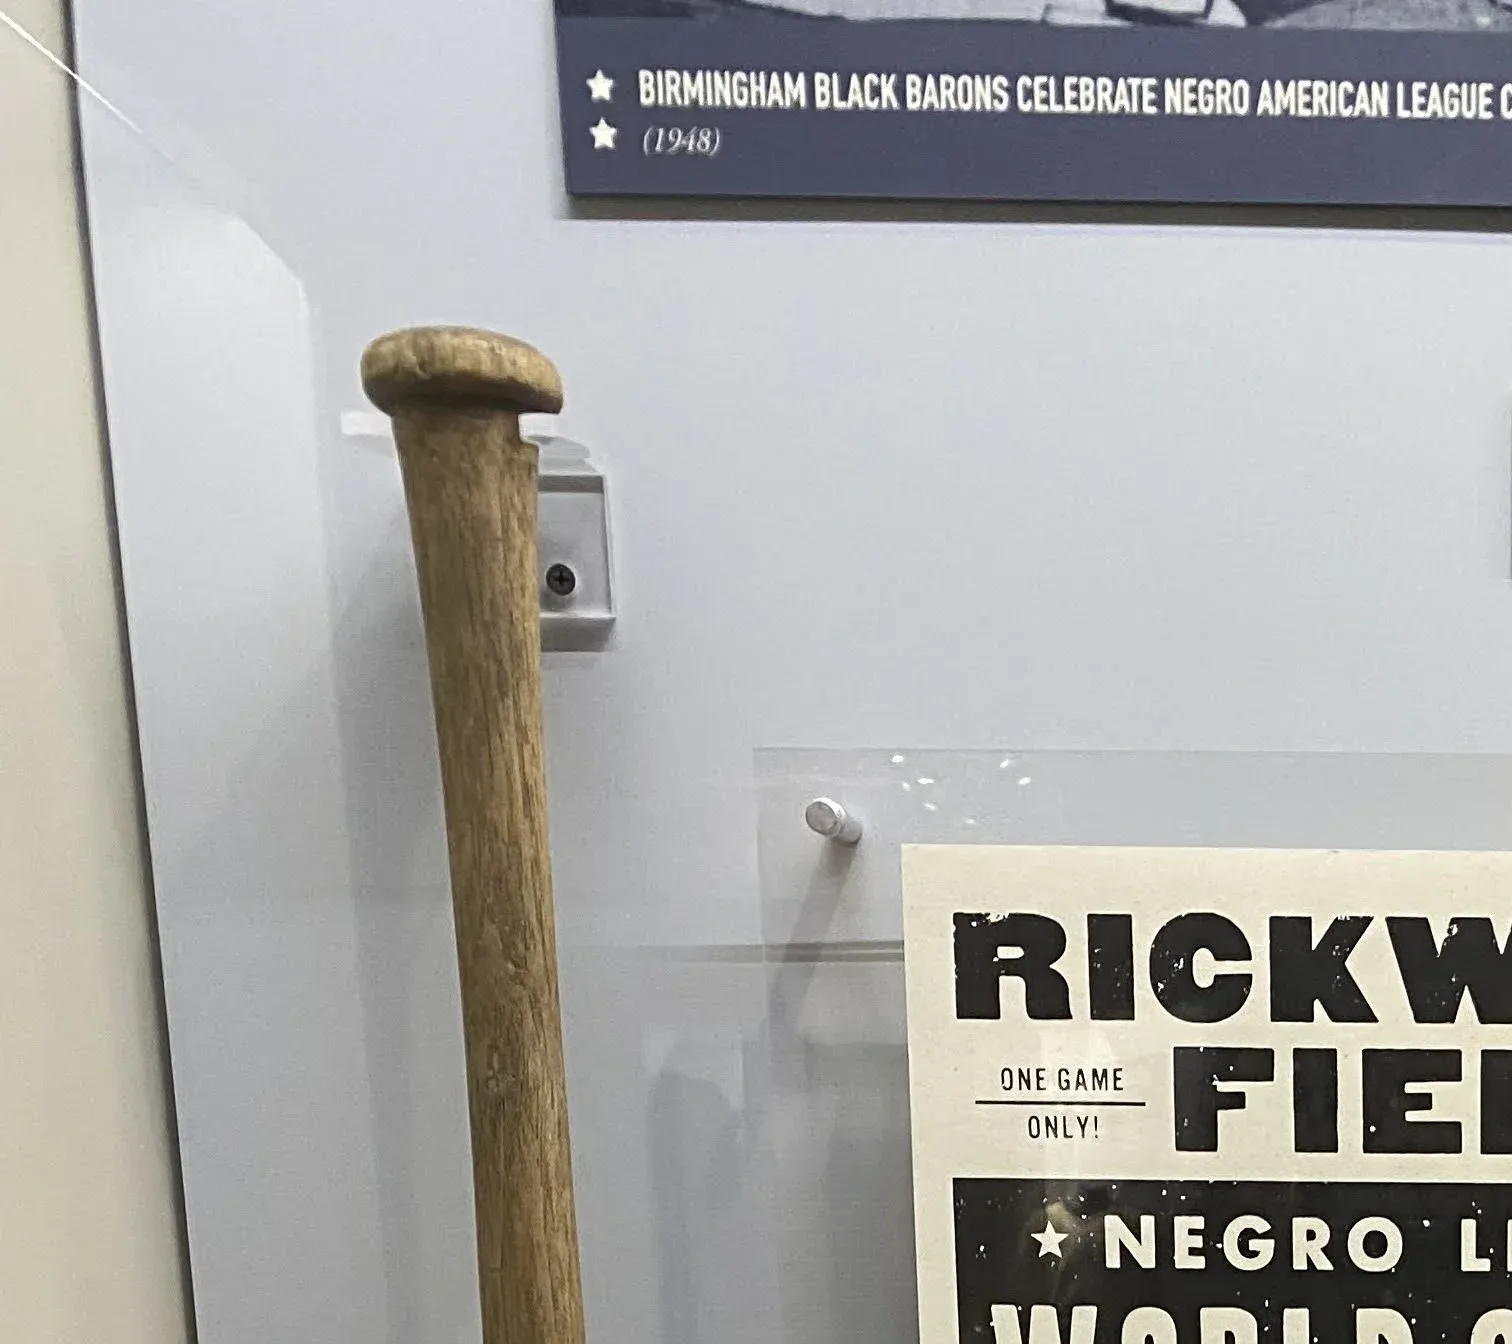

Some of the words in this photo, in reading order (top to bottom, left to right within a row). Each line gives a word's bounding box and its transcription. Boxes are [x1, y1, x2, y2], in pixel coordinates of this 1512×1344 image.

[637, 69, 806, 110] BIRMINGHAM
[815, 73, 898, 110] BLACK
[906, 74, 1009, 112] BARONS
[1017, 77, 1157, 115] CELEBRATE
[1165, 79, 1249, 116] NEGRO
[1257, 81, 1388, 118] AMERICAN
[1396, 83, 1492, 119] LEAGUE
[641, 124, 720, 156] (1948)
[1000, 1067, 1050, 1092] ONE
[1058, 1067, 1125, 1093] GAME
[1027, 1114, 1100, 1140] ONLY!
[1105, 1215, 1404, 1272] NEGRO
